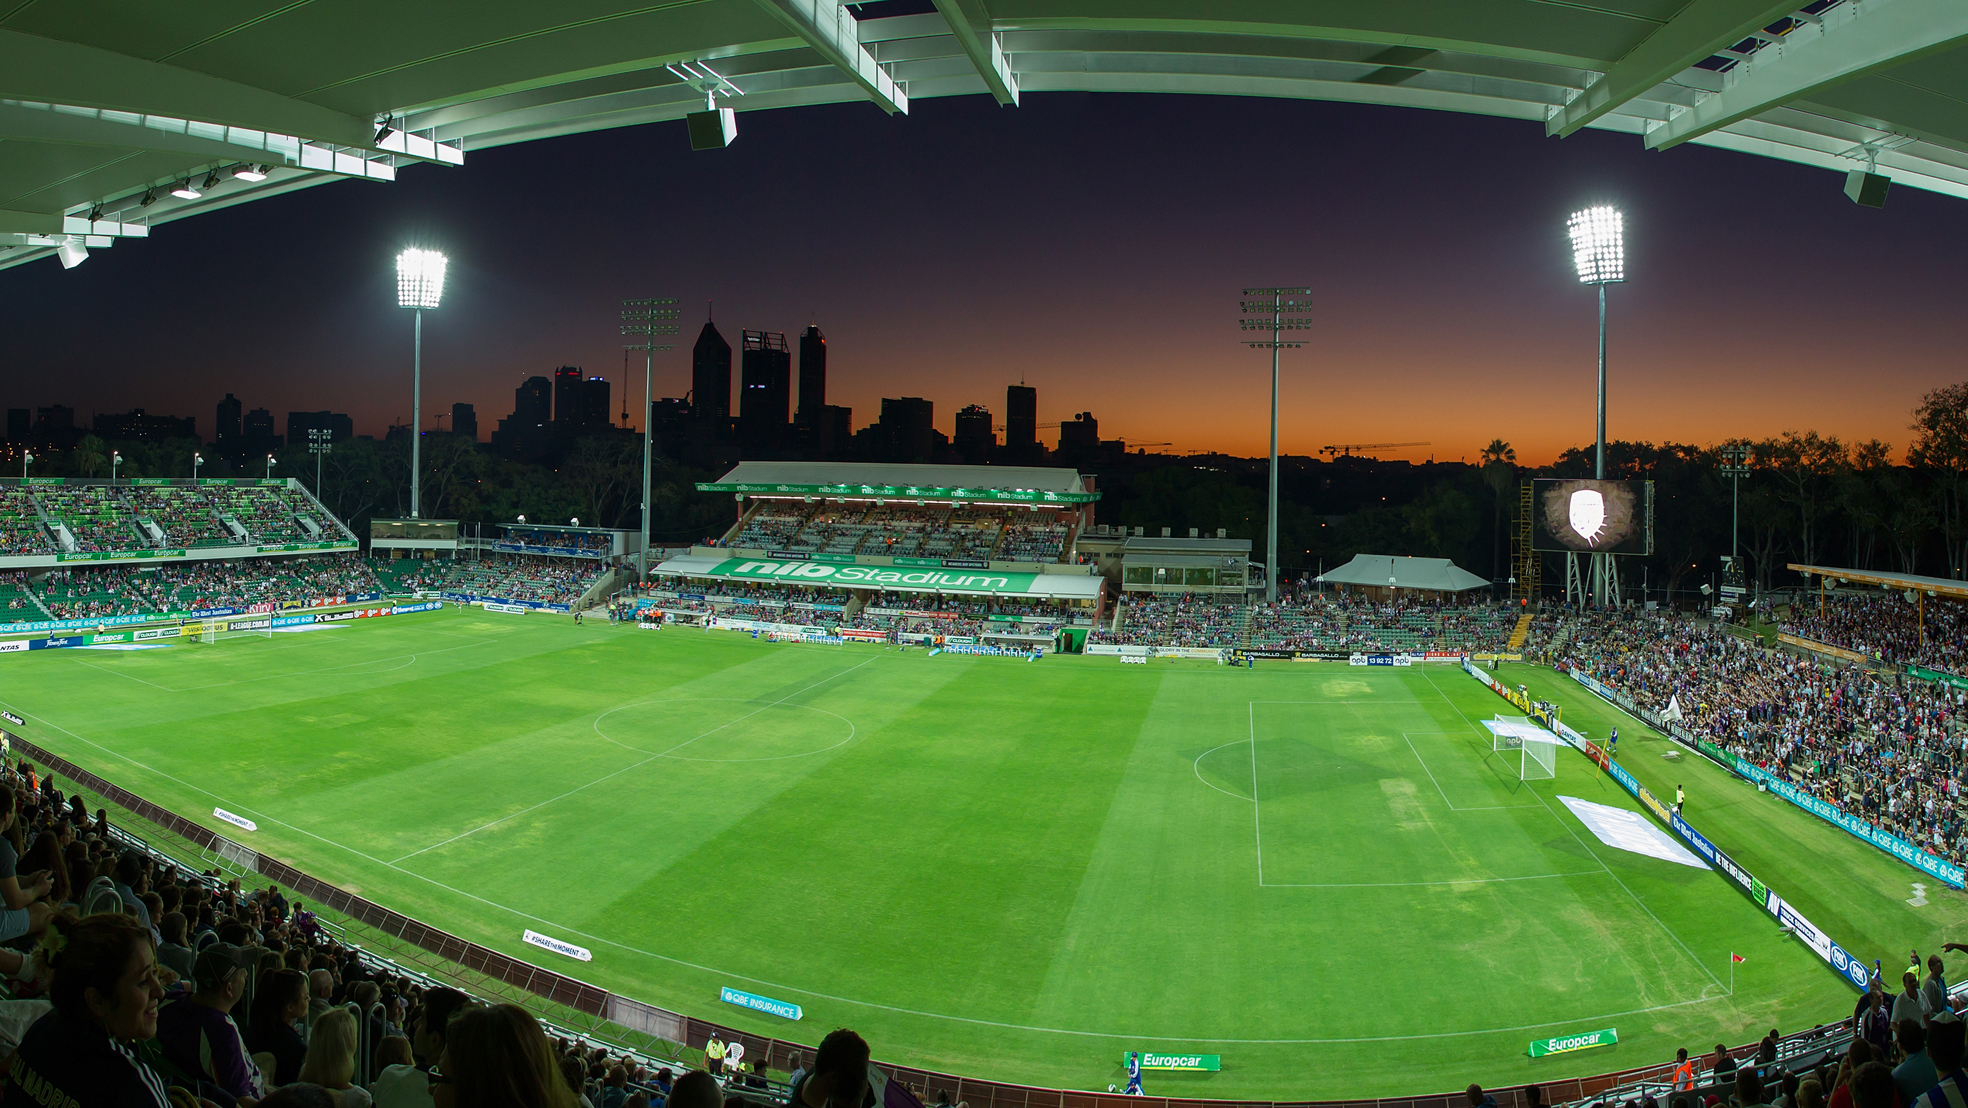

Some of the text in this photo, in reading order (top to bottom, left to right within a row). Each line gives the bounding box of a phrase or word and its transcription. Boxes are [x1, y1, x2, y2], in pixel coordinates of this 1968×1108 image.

[29, 478, 56, 486] Europcar
[138, 478, 162, 486] Europcar
[951, 489, 964, 497] nib
[997, 491, 1010, 499] nib
[1044, 493, 1058, 501] nib
[64, 552, 93, 561] Europcar
[110, 551, 137, 560] Europcar
[734, 561, 1009, 588] nib Stadium
[212, 608, 233, 616] Australian
[93, 633, 124, 643] Europcar
[1769, 779, 1780, 791] QBE
[1785, 787, 1795, 799] QBE
[1802, 795, 1812, 808] QBE
[1820, 803, 1831, 817] QBE
[1858, 823, 1870, 838] QBE
[1878, 833, 1891, 849] QBE
[1899, 845, 1913, 860] QBE
[1923, 856, 1938, 872] QBE
[1948, 867, 1964, 885] QBE
[1680, 822, 1692, 841] West
[1692, 832, 1714, 859] Australian
[1715, 851, 1722, 866] BE
[1721, 856, 1730, 872] THE
[1729, 863, 1752, 891] INFLUENCE
[733, 993, 794, 1018] QBE INSURANCE
[1548, 1033, 1601, 1051] Europcar
[1143, 1053, 1201, 1070] Europcar
